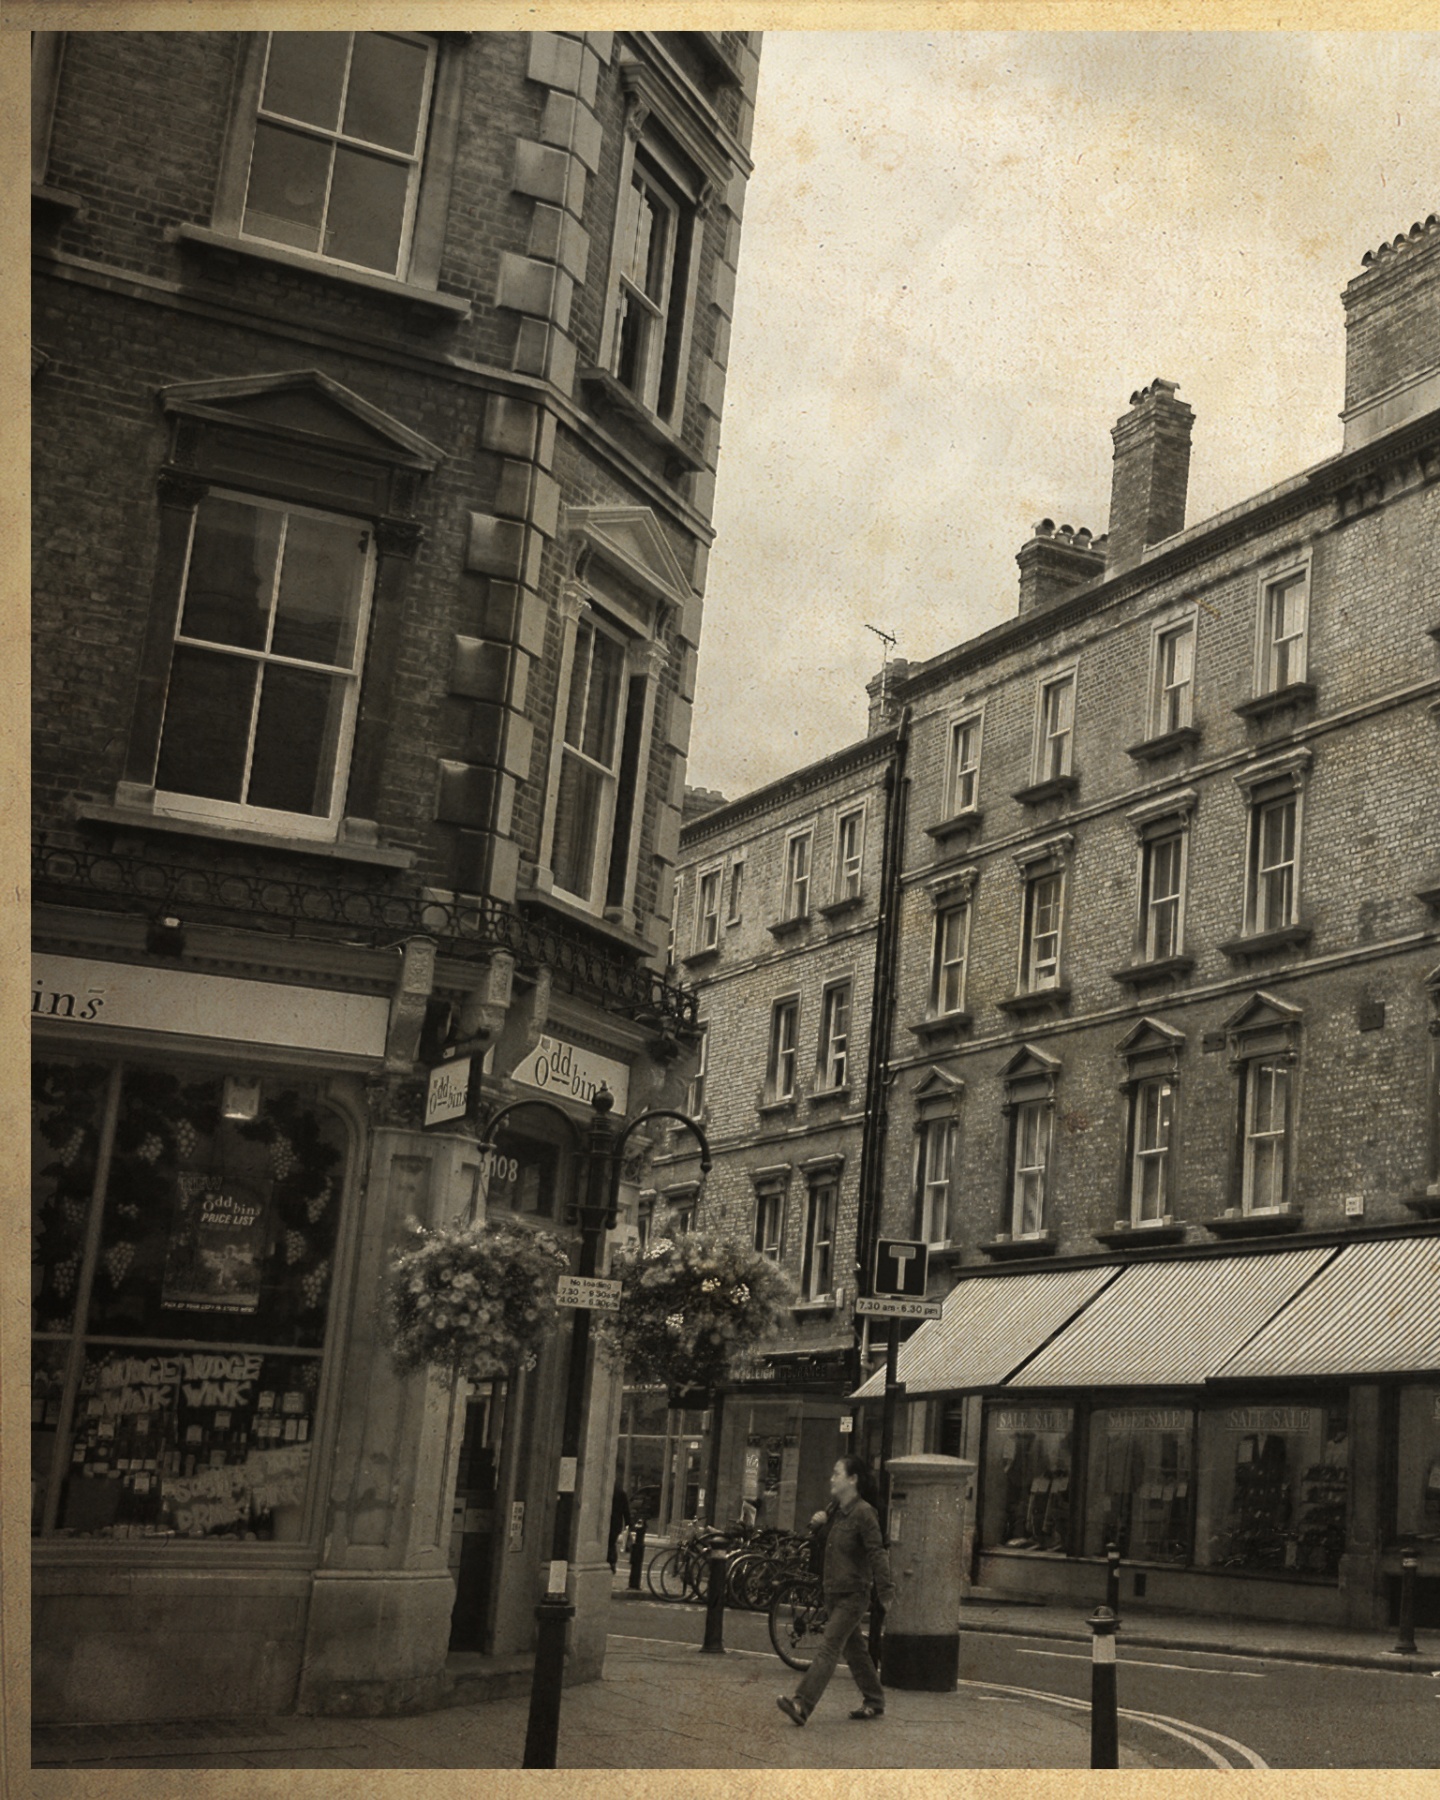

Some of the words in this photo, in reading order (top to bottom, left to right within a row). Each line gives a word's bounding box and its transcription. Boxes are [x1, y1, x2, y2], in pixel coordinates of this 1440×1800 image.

[535, 1043, 604, 1103] Oddbin
[202, 1194, 262, 1216] Oddbins
[201, 1212, 231, 1224] PRICE
[233, 1215, 256, 1227] LIST
[859, 1301, 880, 1311] 7.30
[924, 1307, 938, 1316] pm
[182, 1354, 264, 1382] NUDGE
[182, 1381, 251, 1407] WINK
[1000, 1411, 1029, 1429] SALE
[1108, 1410, 1140, 1428] SALE
[1150, 1410, 1182, 1428] SALE
[1230, 1409, 1266, 1428] SALE
[1271, 1409, 1311, 1428] SALE
